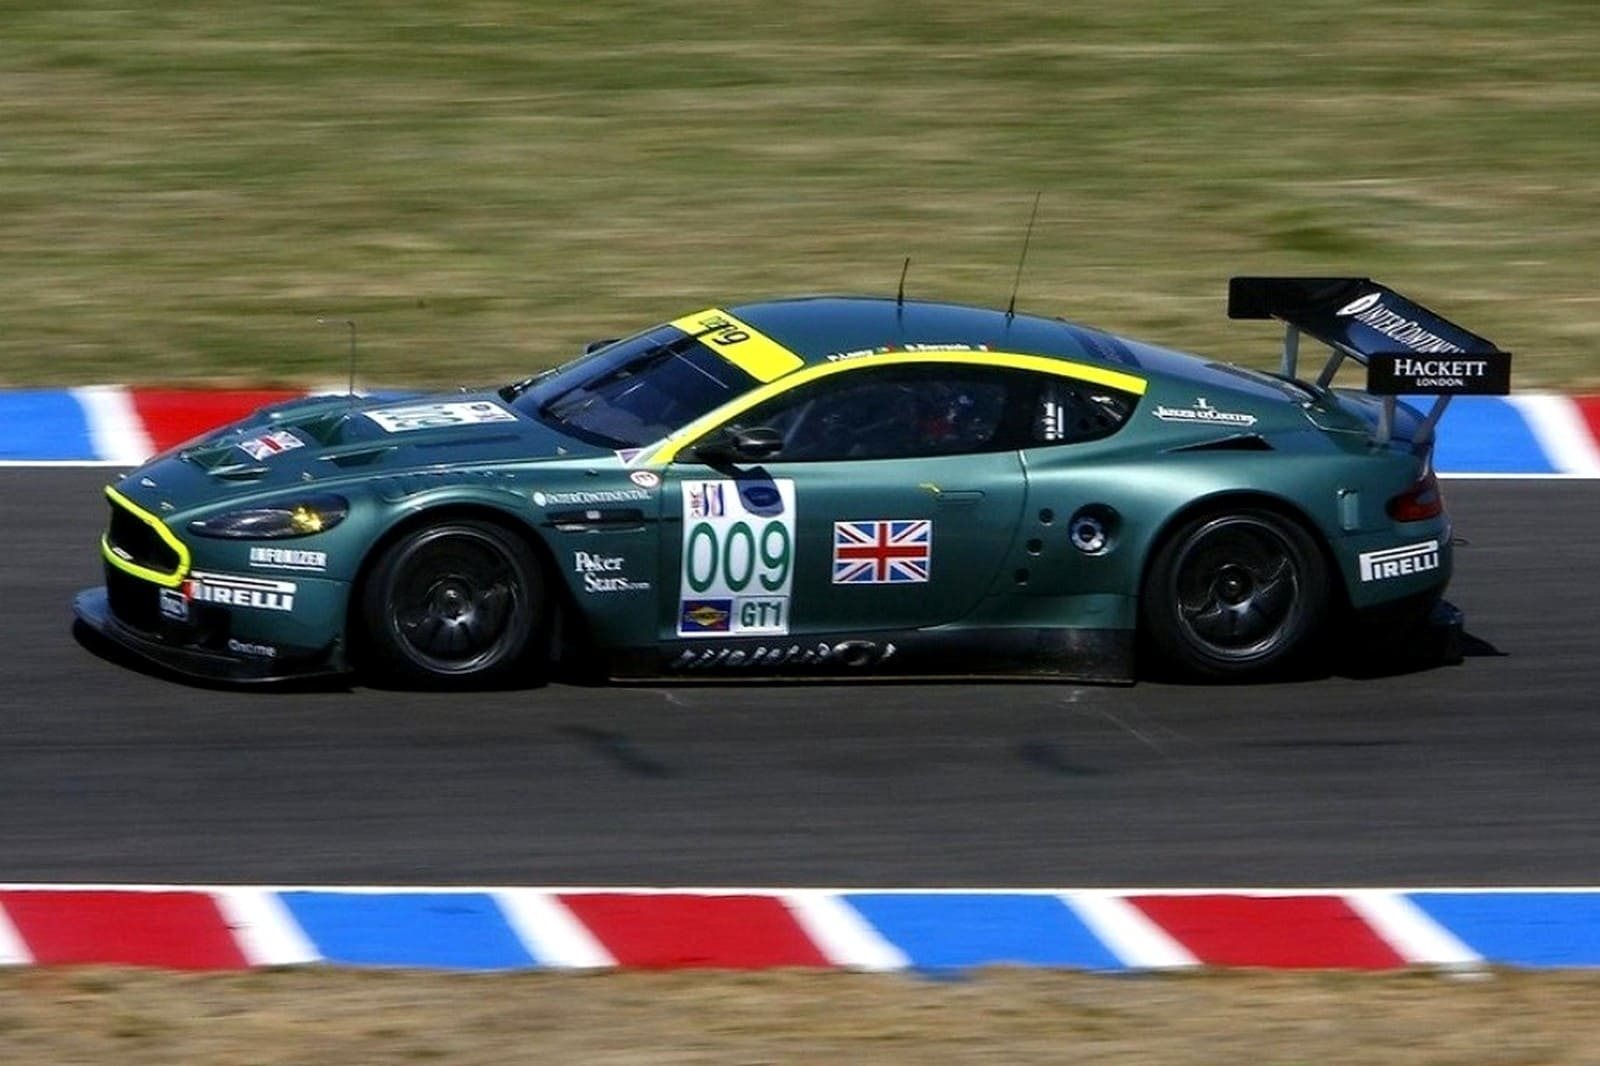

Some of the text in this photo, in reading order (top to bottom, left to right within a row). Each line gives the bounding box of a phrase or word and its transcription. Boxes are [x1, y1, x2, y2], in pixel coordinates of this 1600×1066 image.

[1393, 358, 1487, 377] HACKETT
[1416, 378, 1464, 387] LONDON
[574, 551, 624, 572] Poker
[686, 520, 792, 593] 009
[1359, 540, 1438, 581] PIRELLI
[187, 570, 297, 612] PIRELLI
[741, 601, 782, 628] GT1
